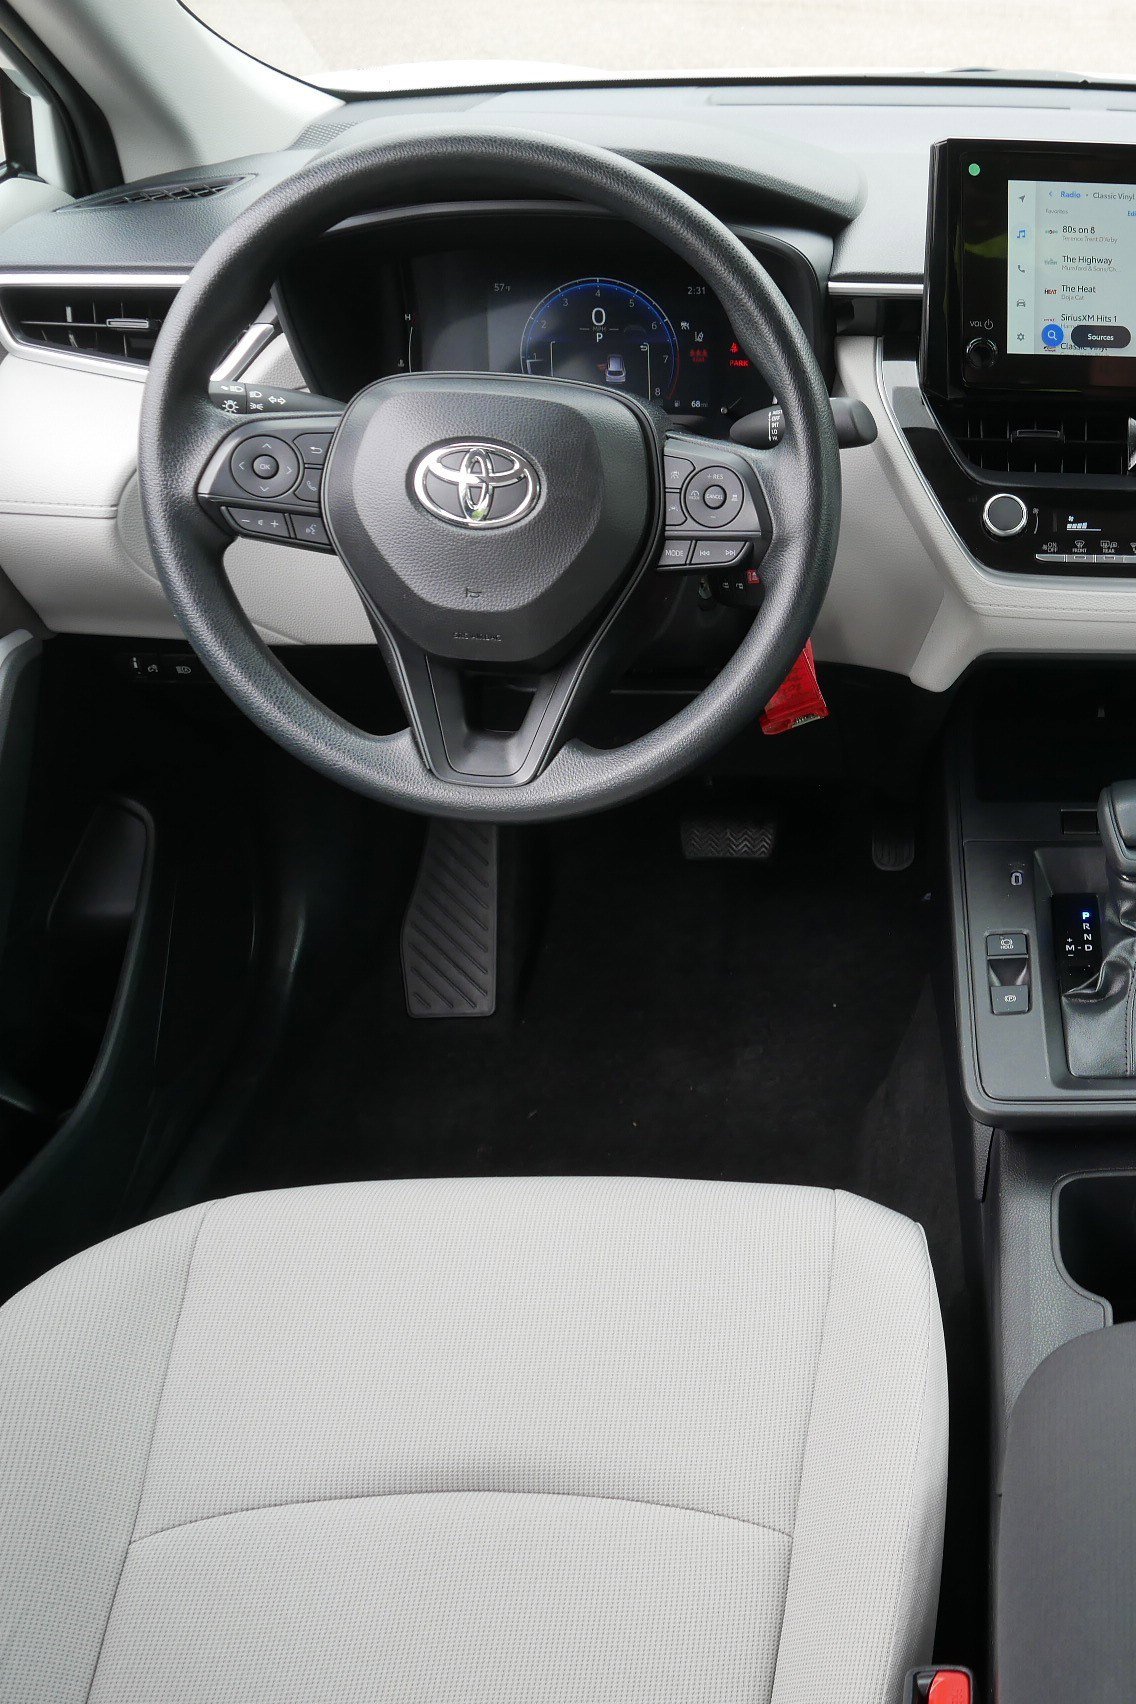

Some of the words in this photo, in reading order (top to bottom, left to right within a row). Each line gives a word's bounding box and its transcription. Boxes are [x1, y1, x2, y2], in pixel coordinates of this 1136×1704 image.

[1060, 190, 1081, 199] Radio
[1118, 194, 1135, 202] Vinyl
[1062, 225, 1077, 234] 80s
[1090, 226, 1096, 234] 8
[1062, 255, 1077, 263] The
[1078, 256, 1113, 266] Highway
[594, 288, 601, 298] 4
[687, 286, 706, 295] 2:31
[1061, 284, 1076, 293] The
[1077, 285, 1097, 293] Heat
[562, 298, 569, 307] 3
[629, 299, 635, 308] 5
[404, 313, 412, 321] H
[591, 307, 606, 326] 0
[1060, 313, 1095, 322] SiriusXM
[541, 320, 547, 329] 2
[651, 321, 658, 330] 6
[969, 320, 982, 328] VOL
[596, 332, 604, 343] P
[1087, 333, 1114, 341] Sources
[662, 354, 669, 364] 7
[729, 359, 750, 367] PARK
[654, 388, 661, 396] 8
[691, 400, 701, 408] 68
[665, 549, 684, 557] MODE
[1082, 911, 1090, 920] P
[1083, 922, 1090, 930] R
[1084, 933, 1092, 941] N
[1065, 943, 1075, 952] M
[1085, 943, 1093, 952] D
